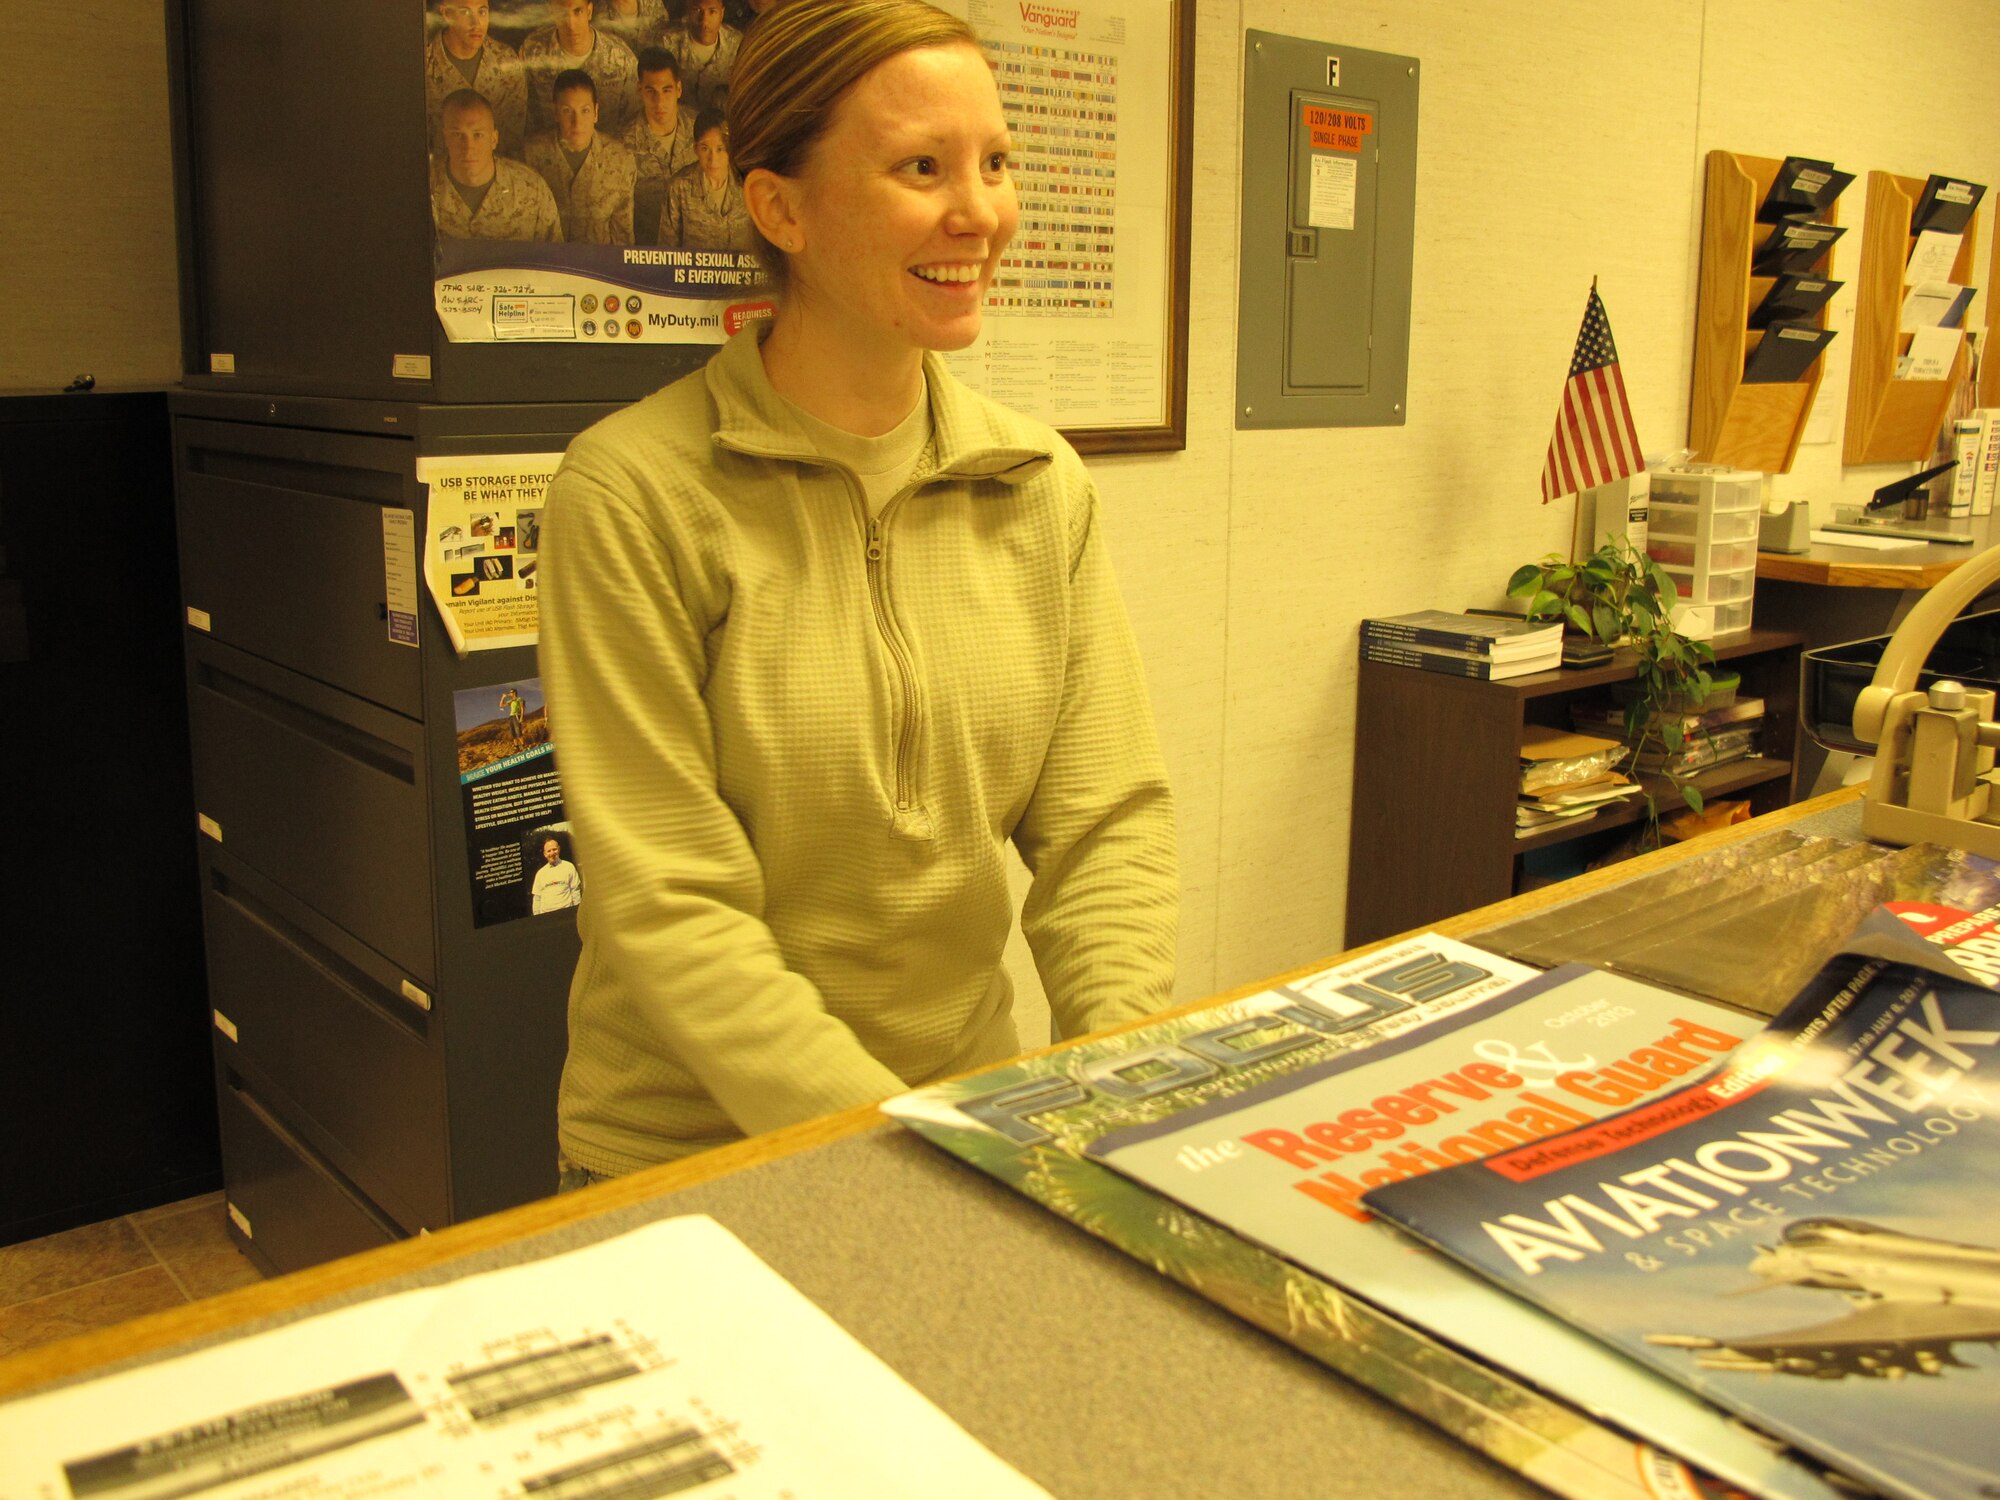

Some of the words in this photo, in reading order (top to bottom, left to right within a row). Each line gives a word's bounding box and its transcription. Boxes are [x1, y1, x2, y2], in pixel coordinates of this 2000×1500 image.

[1020, 2, 1077, 28] Vanguard
[1330, 60, 1337, 86] F
[1310, 111, 1342, 128] 120/208
[1344, 115, 1365, 130] VOLTS
[1314, 132, 1335, 145] SINGLE
[1338, 134, 1358, 148] PHASE
[624, 250, 692, 266] PREVENTING
[696, 252, 734, 267] SEXUAL
[675, 269, 685, 282] IS
[688, 270, 751, 285] EVERYONE'S
[649, 314, 718, 329] MyDuty.mil
[733, 308, 772, 320] READINESS
[441, 478, 462, 487] USB
[466, 475, 516, 486] STORAGE
[520, 474, 553, 484] DEVIC
[464, 491, 478, 500] BE
[481, 490, 512, 499] WHAT
[516, 488, 543, 497] THEY
[497, 596, 522, 604] against
[486, 763, 502, 775] YOUR
[503, 755, 525, 766] HEALTH
[526, 747, 545, 758] GOALS
[1424, 977, 1511, 1014] Journal
[1791, 1017, 1825, 1050] STARTS
[1822, 990, 1854, 1023] AFTER
[1848, 964, 1877, 993] PAGE
[1871, 1010, 1895, 1034] JULY
[1898, 977, 1926, 1005] 2013
[1544, 998, 1610, 1029] October
[1587, 1005, 1636, 1028] 2013
[953, 951, 1493, 1148] FOCUS
[1176, 1140, 1244, 1172] the
[1239, 1063, 1524, 1170] Reserve
[1472, 1039, 1597, 1088] &
[1292, 1091, 1598, 1224] National
[1555, 1017, 1744, 1106] Guard
[1508, 1136, 1603, 1172] Defense
[1607, 1096, 1718, 1143] Technology
[1624, 1252, 1664, 1273] &
[1665, 1197, 1786, 1257] SPACE
[1779, 1088, 1985, 1200] TECHNOLOGY
